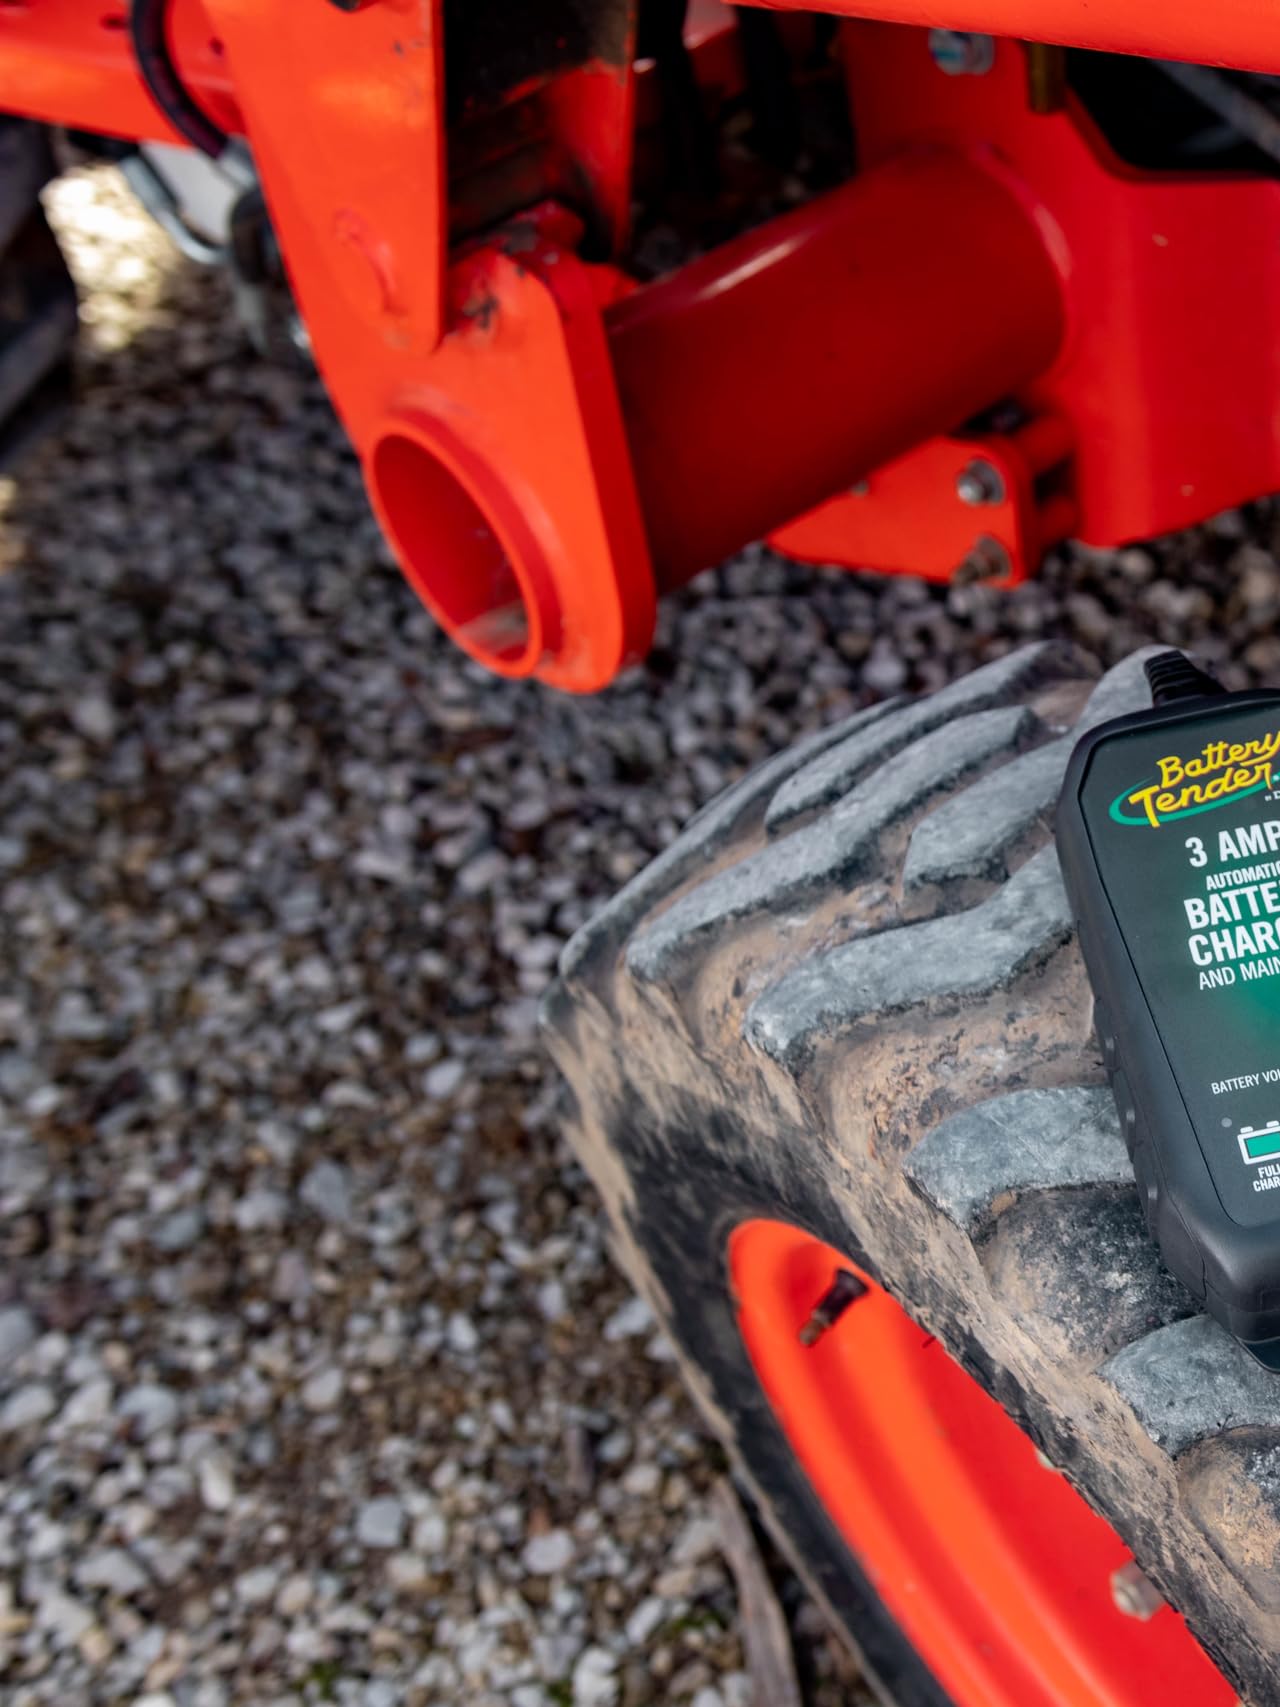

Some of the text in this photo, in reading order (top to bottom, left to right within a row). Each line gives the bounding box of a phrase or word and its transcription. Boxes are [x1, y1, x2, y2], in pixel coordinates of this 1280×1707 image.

[1129, 762, 1273, 828] Tender
[1185, 837, 1208, 867] 3
[1199, 966, 1236, 990] AND
[1210, 1073, 1260, 1095] BATTERY
